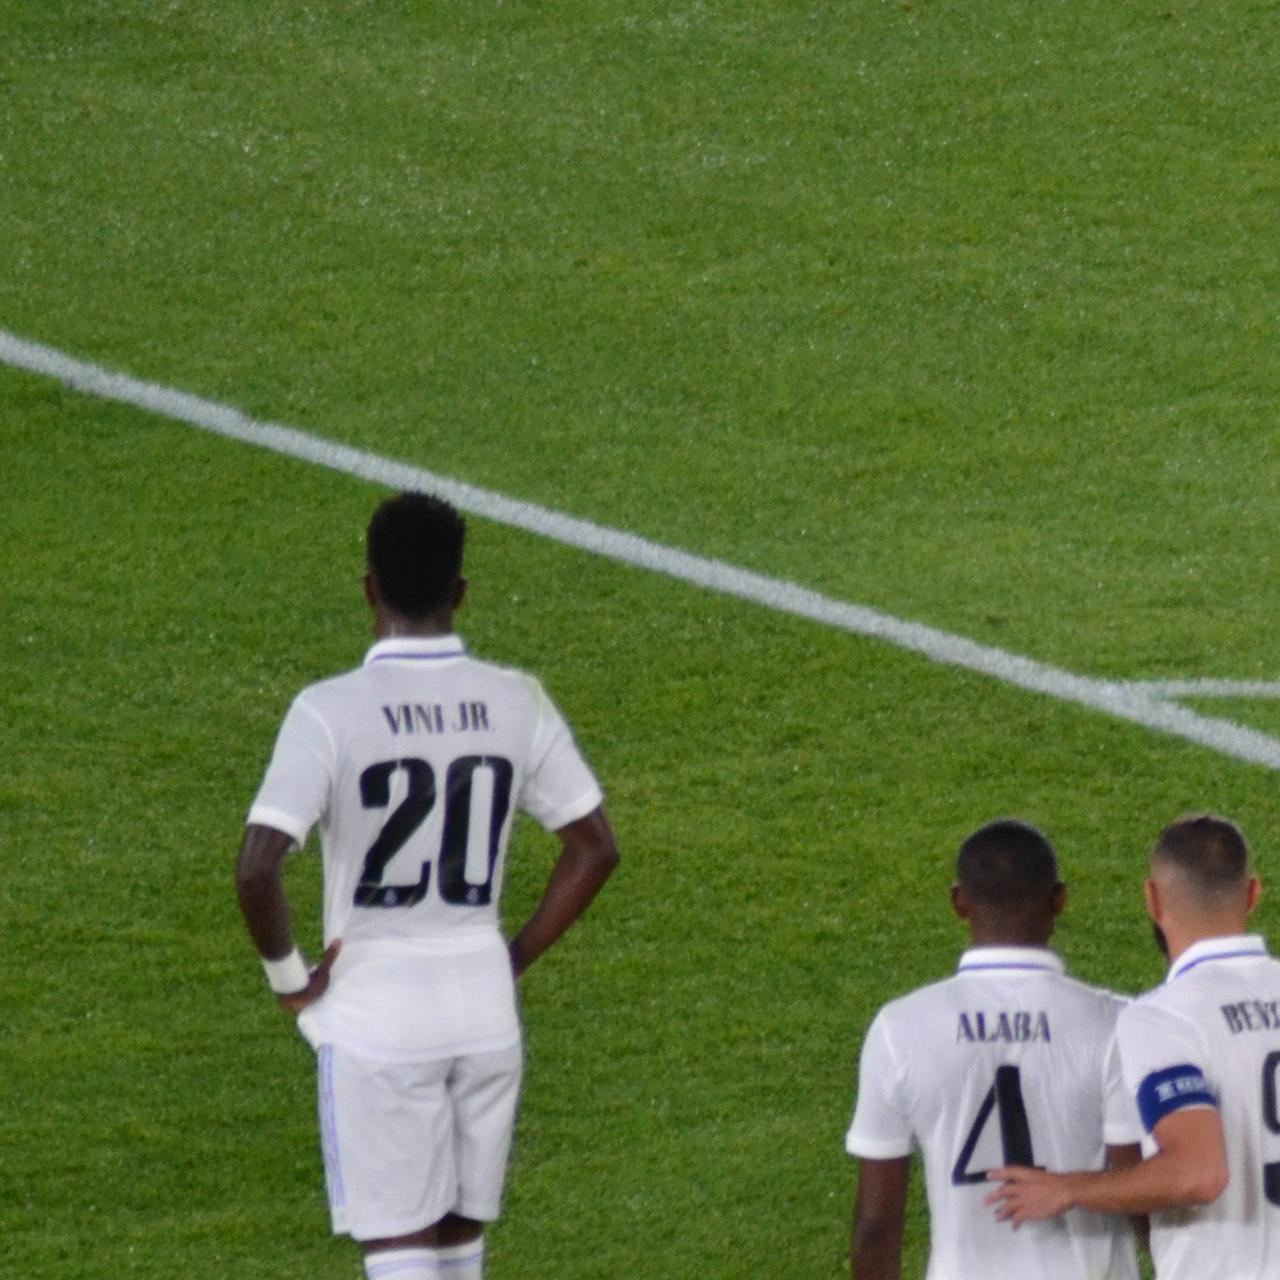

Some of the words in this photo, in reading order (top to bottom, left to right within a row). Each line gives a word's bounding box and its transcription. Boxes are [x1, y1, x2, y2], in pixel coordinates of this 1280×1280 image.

[382, 703, 444, 735] VINI
[353, 754, 513, 908] 20
[956, 1011, 1051, 1044] ALABA
[952, 1064, 1047, 1186] 4
